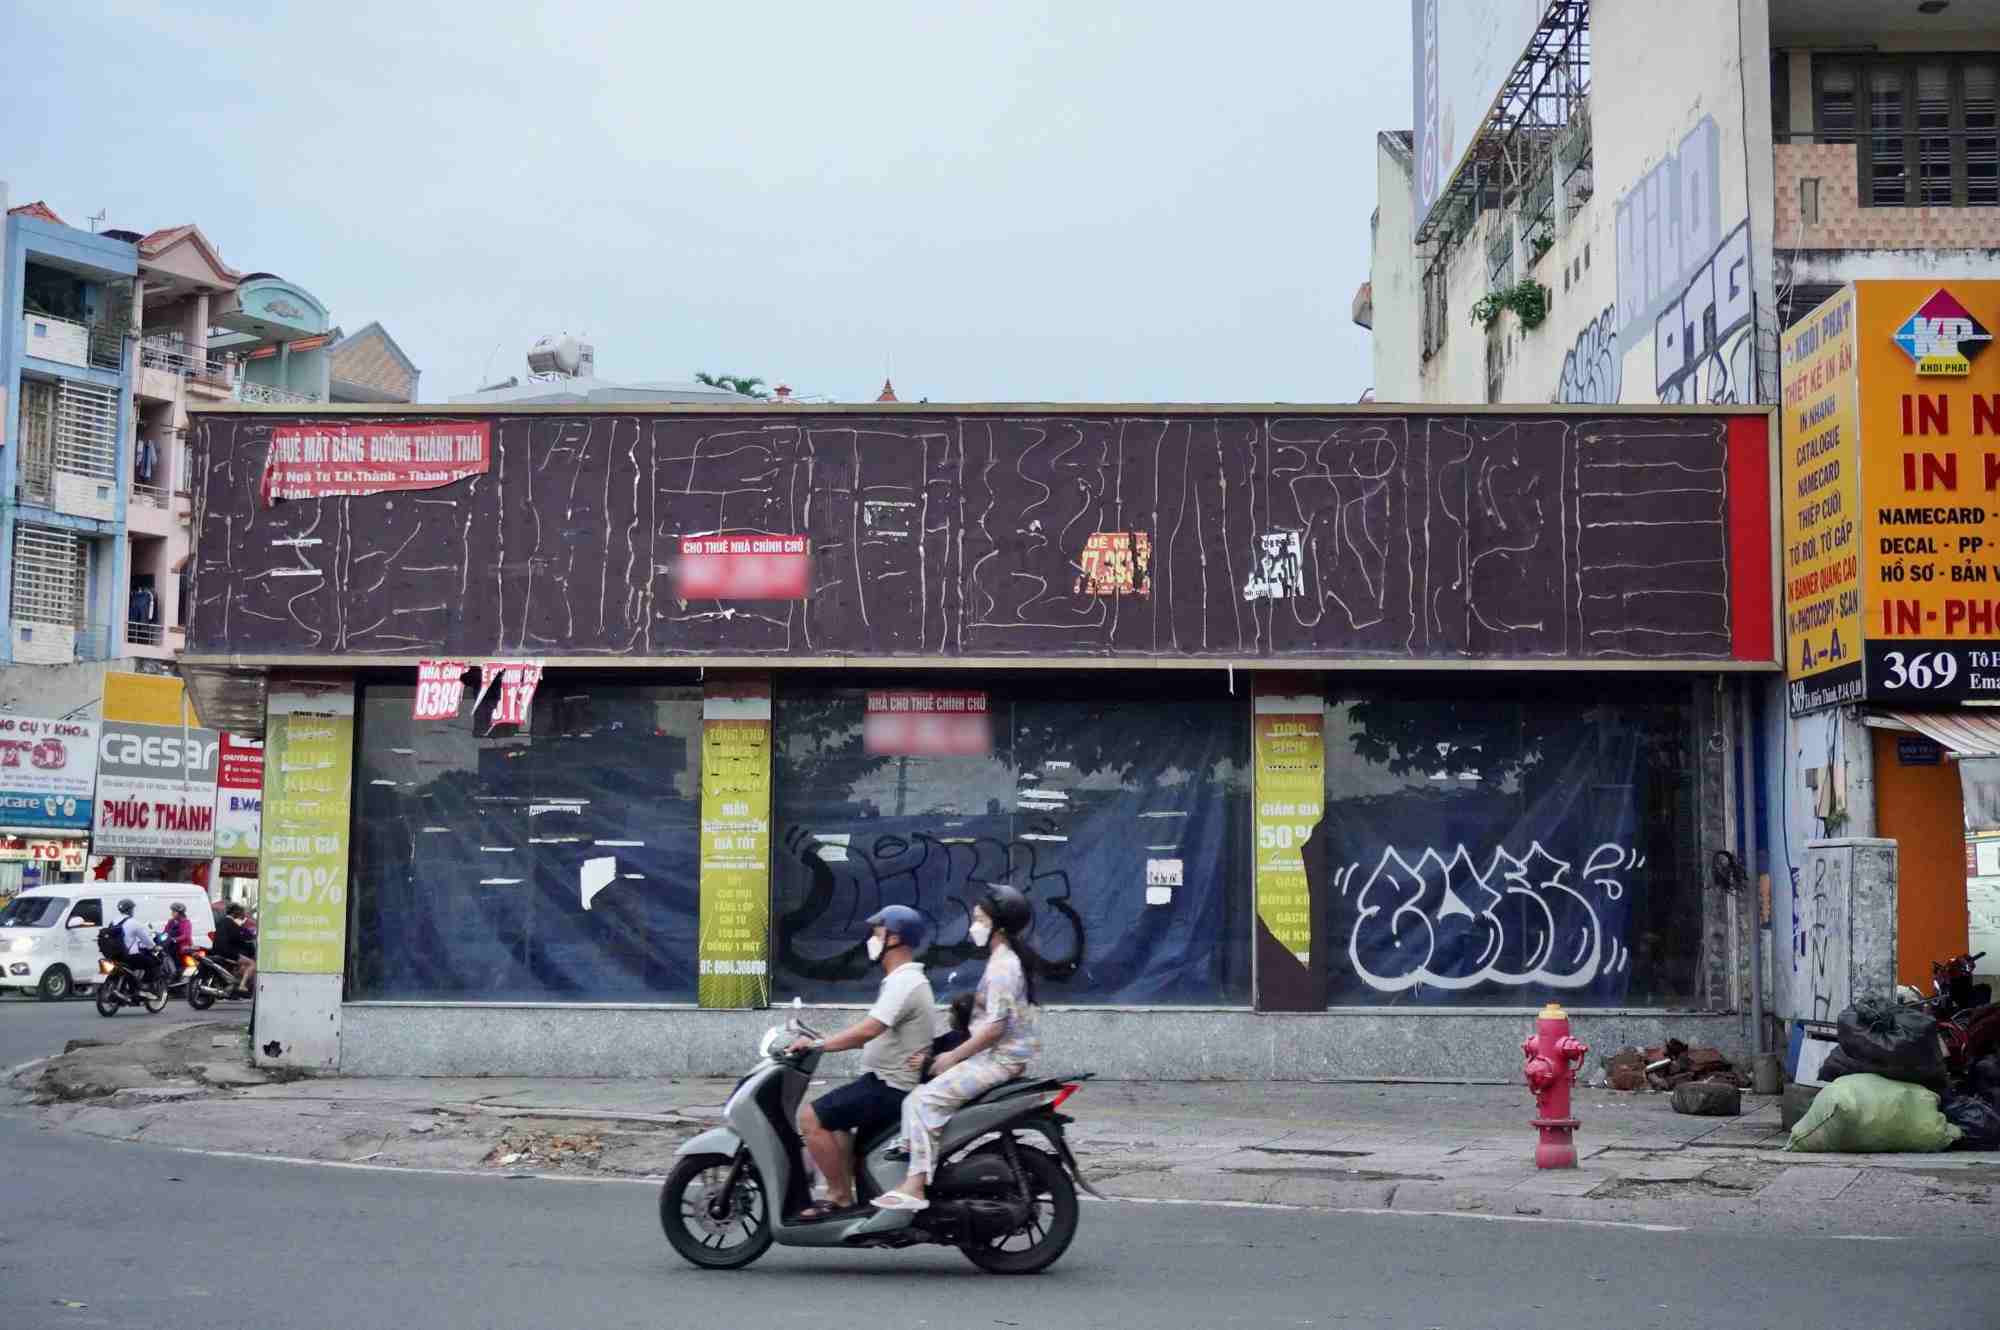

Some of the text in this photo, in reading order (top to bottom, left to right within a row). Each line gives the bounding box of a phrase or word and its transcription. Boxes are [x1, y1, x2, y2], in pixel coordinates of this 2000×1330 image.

[1902, 394, 1949, 436] IN
[1796, 424, 1840, 467] CATALOGUE
[1798, 460, 1840, 497] NAMECARD
[1904, 453, 1957, 491] IN
[1879, 508, 1985, 525] NAMECARD
[683, 542, 702, 554] CHO
[704, 540, 729, 554] THUÊ
[731, 540, 750, 553] NHÀ
[753, 539, 782, 552] CHÍNH
[1880, 537, 1983, 554] DECAL PP
[1881, 558, 1904, 582] HỒ
[1910, 562, 1935, 582] SƠ
[1951, 558, 1987, 582] BẢN
[1883, 652, 1958, 689] 369
[1969, 651, 1989, 667] Tô
[1791, 681, 1805, 712] 369
[100, 733, 219, 770] caesar
[101, 794, 213, 832] PHÚC THÀNH
[266, 864, 343, 905] 50%
